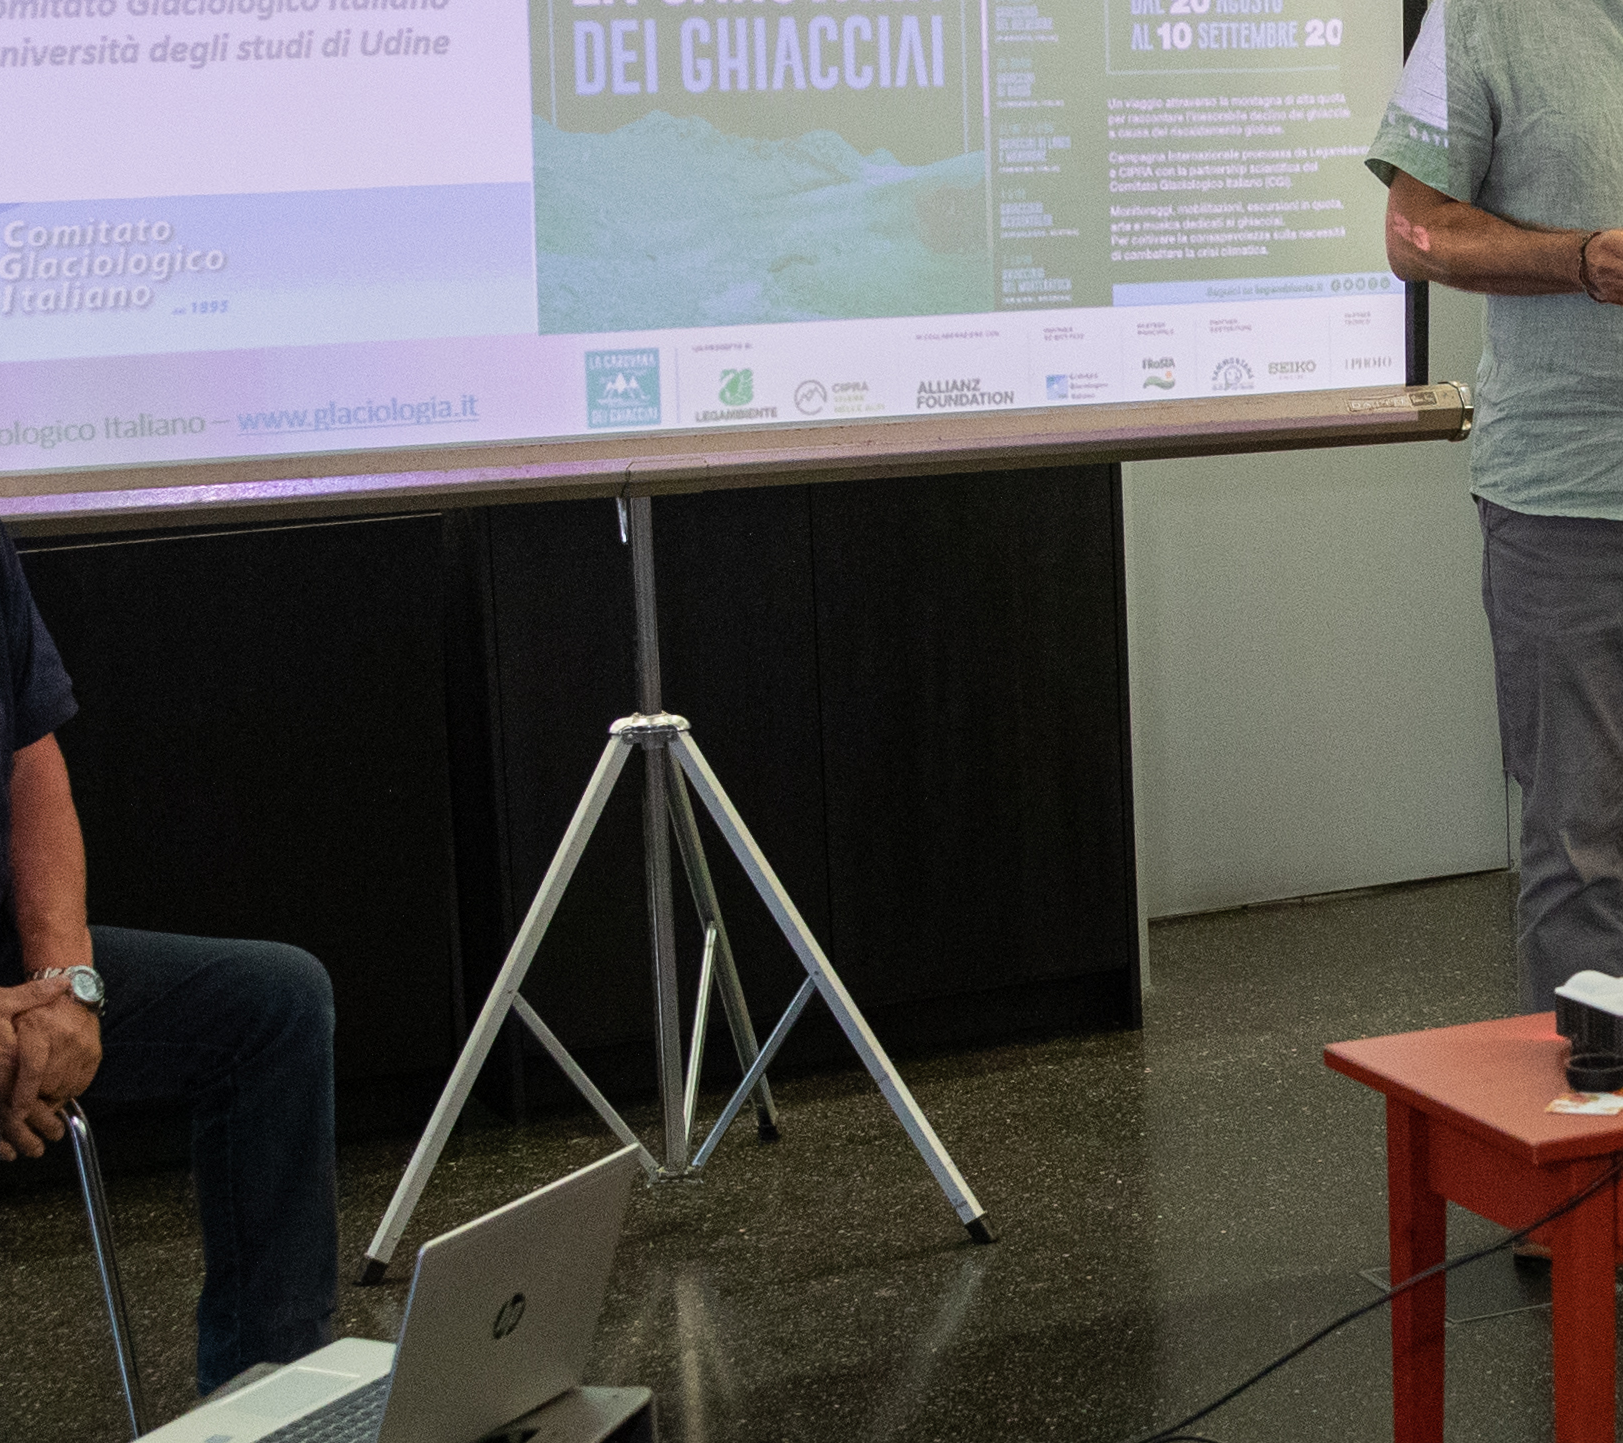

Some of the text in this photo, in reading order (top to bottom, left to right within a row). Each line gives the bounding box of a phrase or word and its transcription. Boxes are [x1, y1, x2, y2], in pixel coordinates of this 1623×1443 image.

[148, 32, 228, 69] degli
[235, 30, 314, 62] studi
[321, 29, 350, 59] di
[360, 29, 451, 57] Udine
[1131, 19, 1299, 51] AL 10 SETTEMBRE
[576, 17, 659, 96] DEI
[680, 13, 945, 94] GHIACCIAI
[3, 218, 175, 249] Comitato
[0, 281, 154, 316] Italiano
[1267, 359, 1317, 376] SEIKO
[916, 378, 982, 396] ALLIANZ
[916, 390, 1016, 409] FOUNDATION
[103, 394, 479, 440] Italiano www.glaciologia.it
